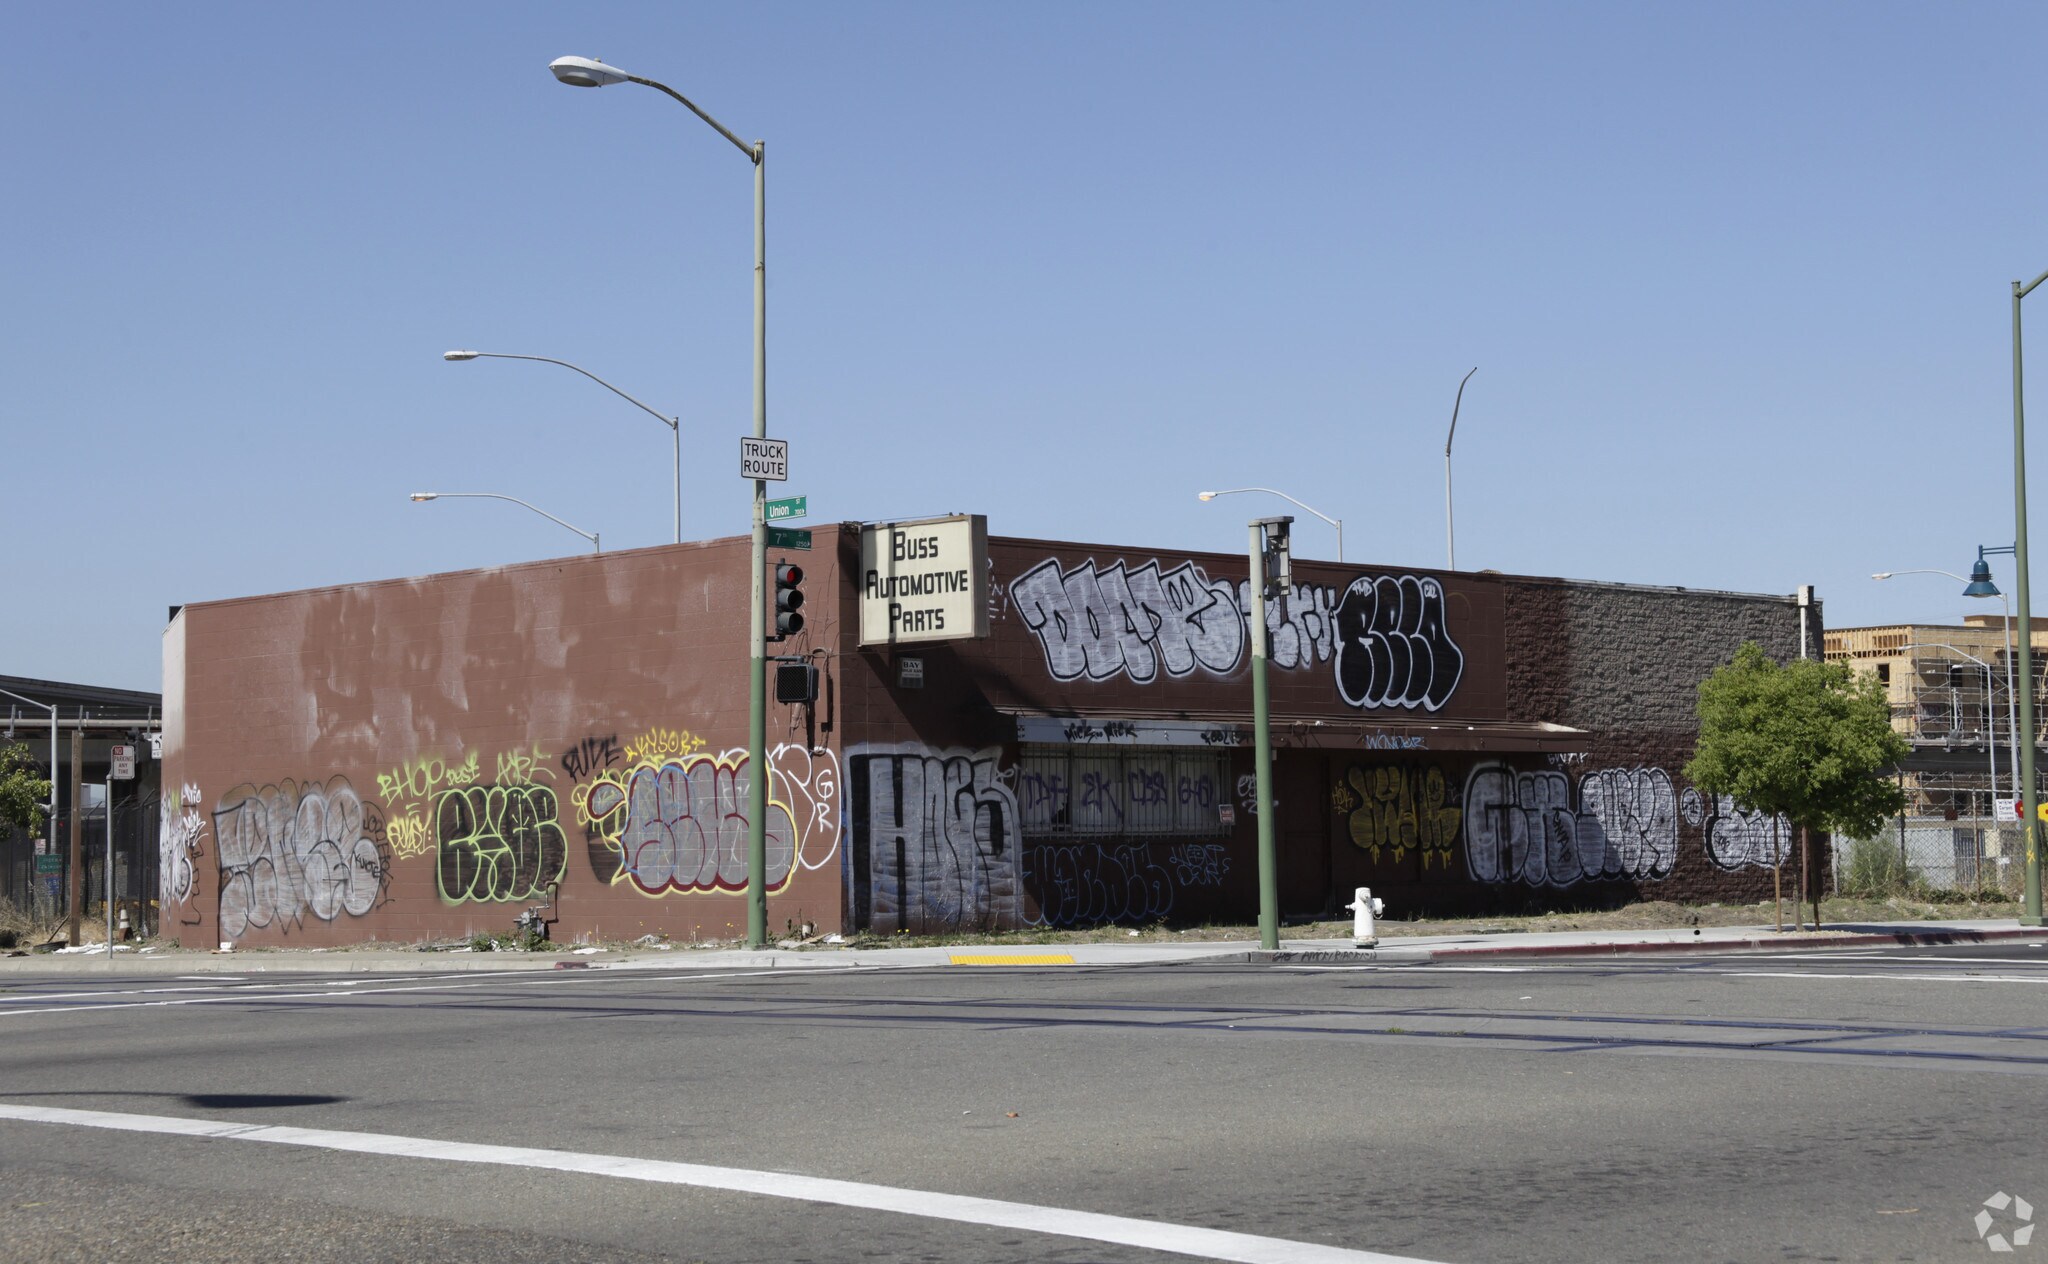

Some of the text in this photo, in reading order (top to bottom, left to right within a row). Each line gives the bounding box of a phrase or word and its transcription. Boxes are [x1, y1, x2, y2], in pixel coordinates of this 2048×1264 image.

[744, 443, 784, 459] TRUCK
[743, 459, 785, 476] ROUTE
[769, 504, 790, 518] Union
[865, 569, 968, 600] AUTOMOTIVE
[889, 602, 945, 634] PARTS
